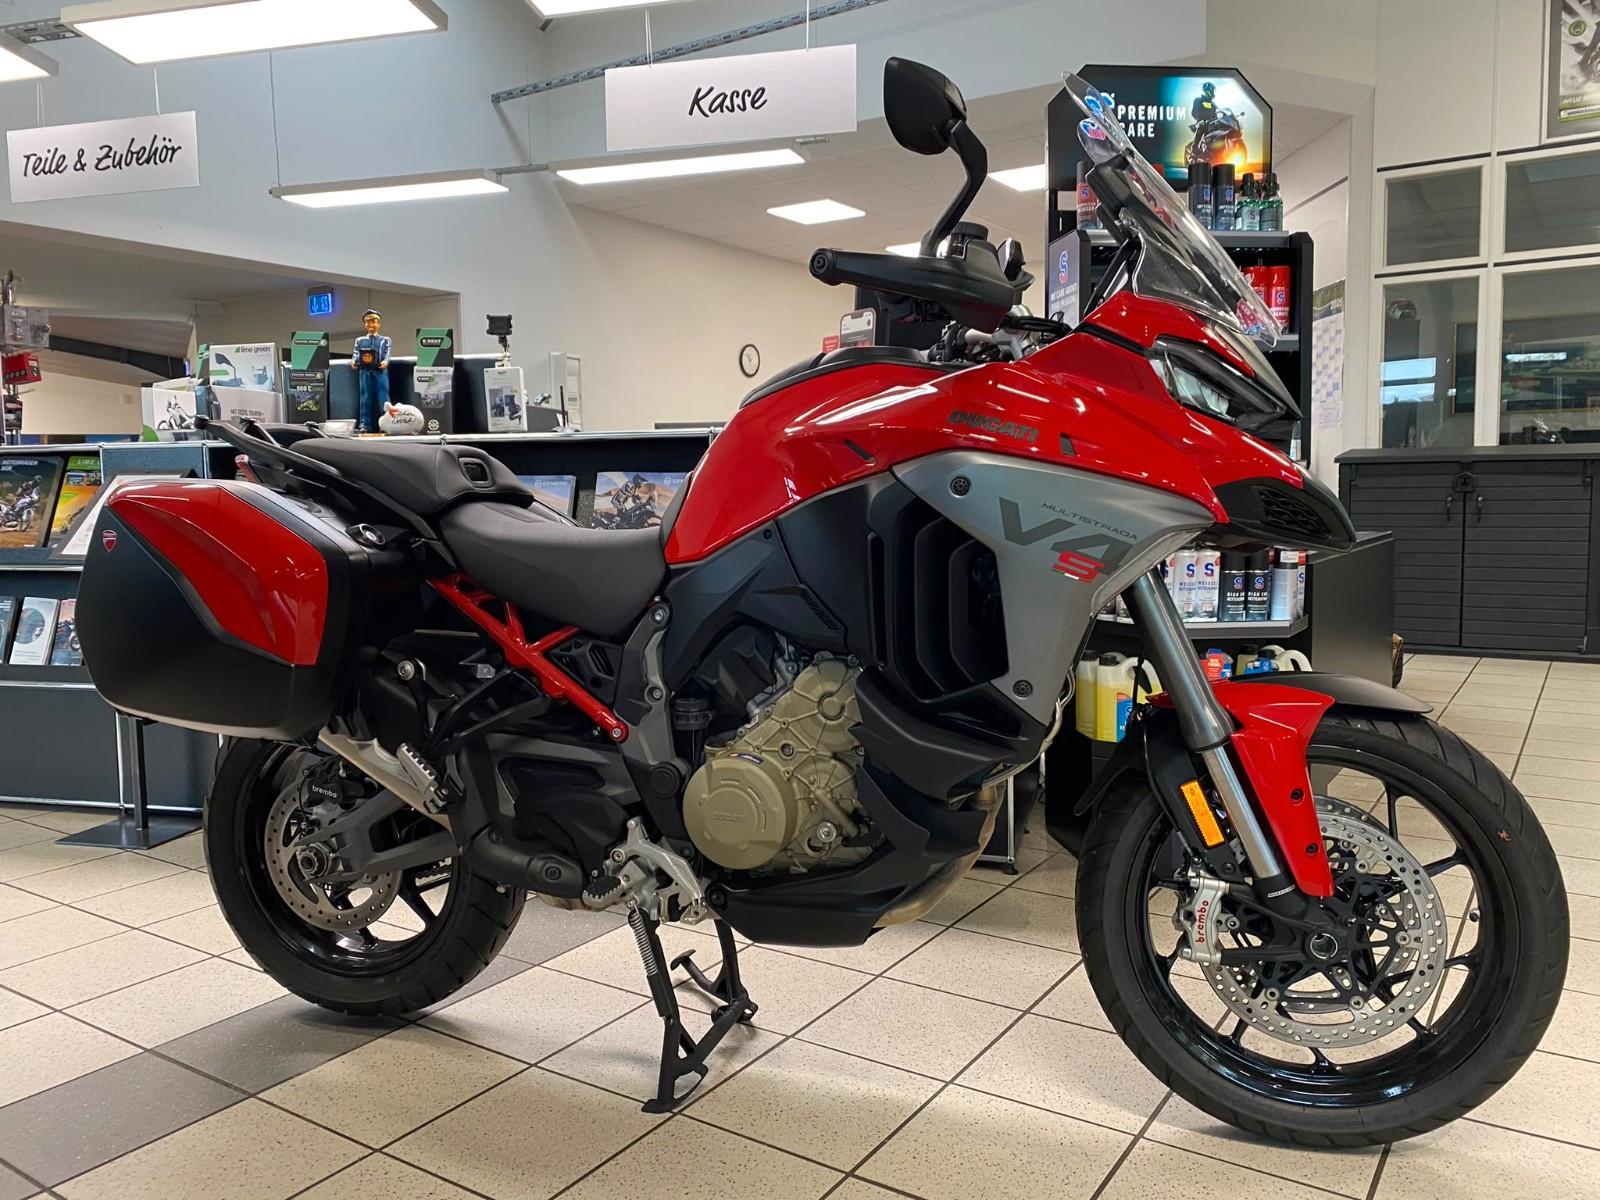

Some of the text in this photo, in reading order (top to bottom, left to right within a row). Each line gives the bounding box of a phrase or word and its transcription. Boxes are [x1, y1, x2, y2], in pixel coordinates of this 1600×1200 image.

[688, 86, 768, 118] Kasse
[1117, 104, 1186, 121] PREMIUM
[23, 134, 182, 177] Teile & Zubehör
[253, 346, 271, 354] green
[947, 410, 1039, 442] DUCATI
[998, 496, 1133, 576] V4
[1041, 502, 1138, 541] MULTISTRADA
[1052, 550, 1104, 583] S
[312, 784, 338, 799] brembo
[1196, 900, 1209, 944] brembo
